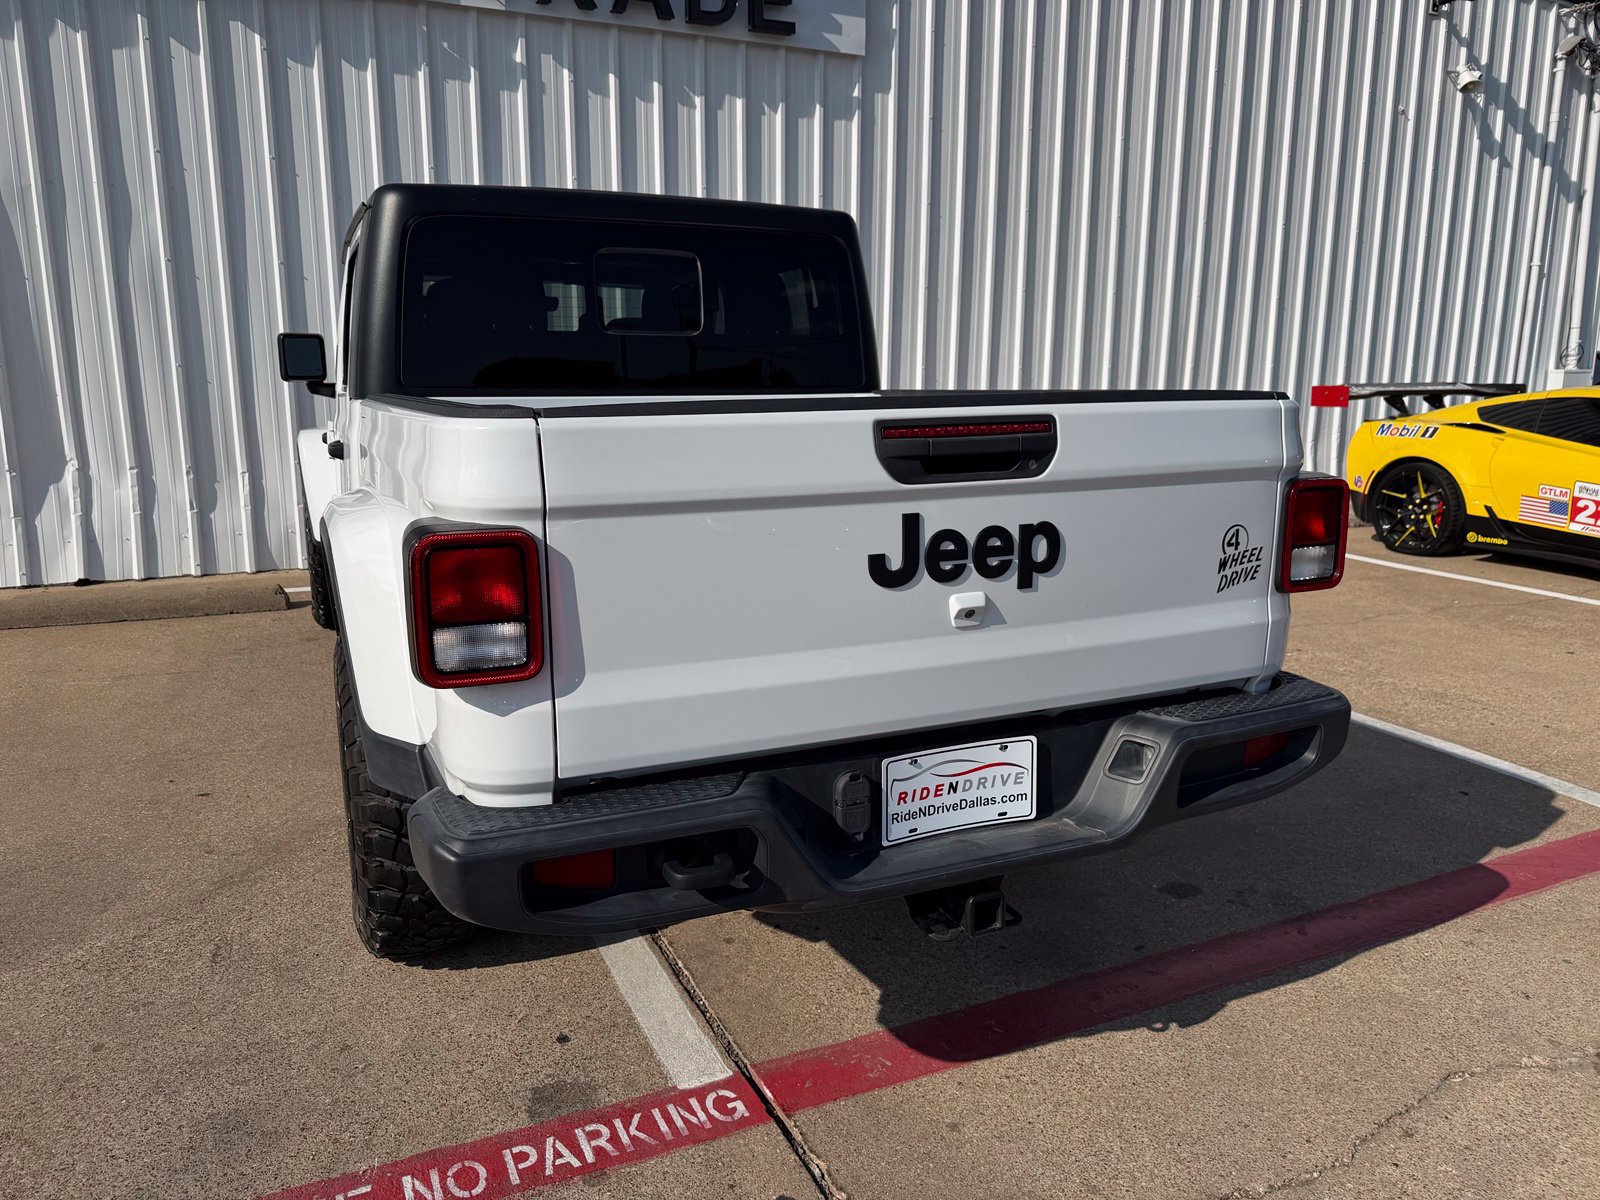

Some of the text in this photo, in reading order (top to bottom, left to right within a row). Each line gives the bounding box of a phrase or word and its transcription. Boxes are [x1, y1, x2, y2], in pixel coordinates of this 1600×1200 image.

[1375, 423, 1422, 438] Mobil
[1540, 486, 1569, 499] GTLM
[1575, 499, 1600, 526] 2
[867, 512, 1061, 590] Jeep
[1226, 528, 1240, 551] 4
[1478, 534, 1509, 546] brembo
[1217, 546, 1263, 575] WHEEL
[1216, 564, 1261, 594] DRIVE
[896, 771, 1026, 806] RIDENDRIVE
[891, 792, 1028, 825] RideNDriveDallas.com
[402, 1088, 751, 1200] NO PARKING
